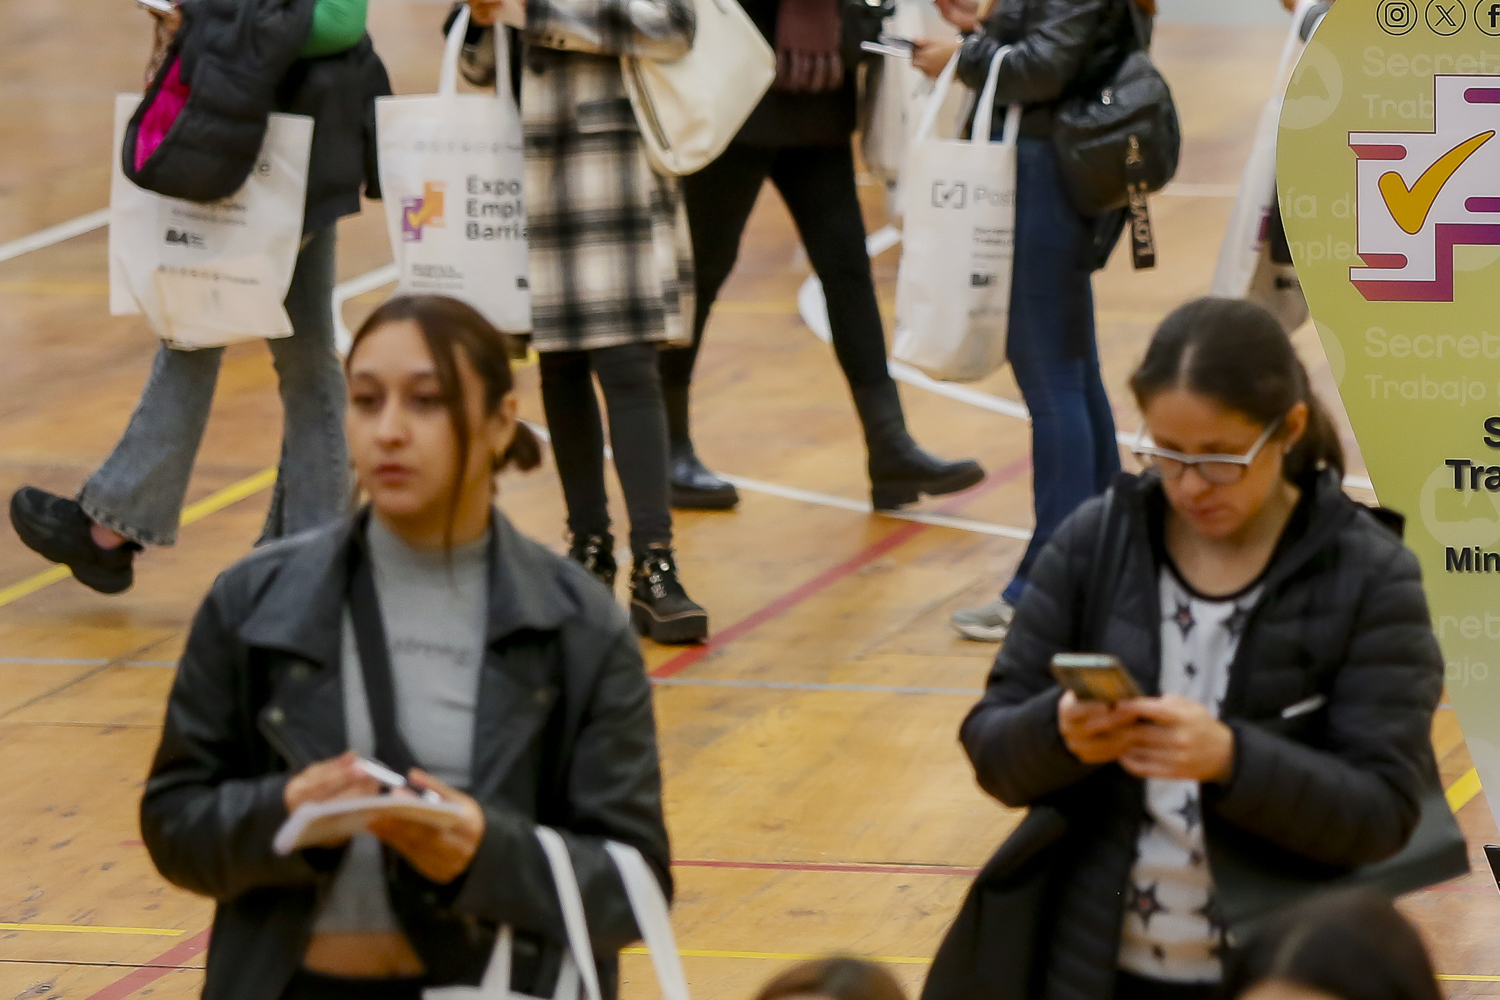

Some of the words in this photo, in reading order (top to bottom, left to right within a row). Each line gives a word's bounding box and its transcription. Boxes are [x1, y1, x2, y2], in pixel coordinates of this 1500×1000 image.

[1361, 93, 1435, 121] Trab
[466, 175, 521, 196] Expo
[1364, 374, 1487, 407] Trabajo
